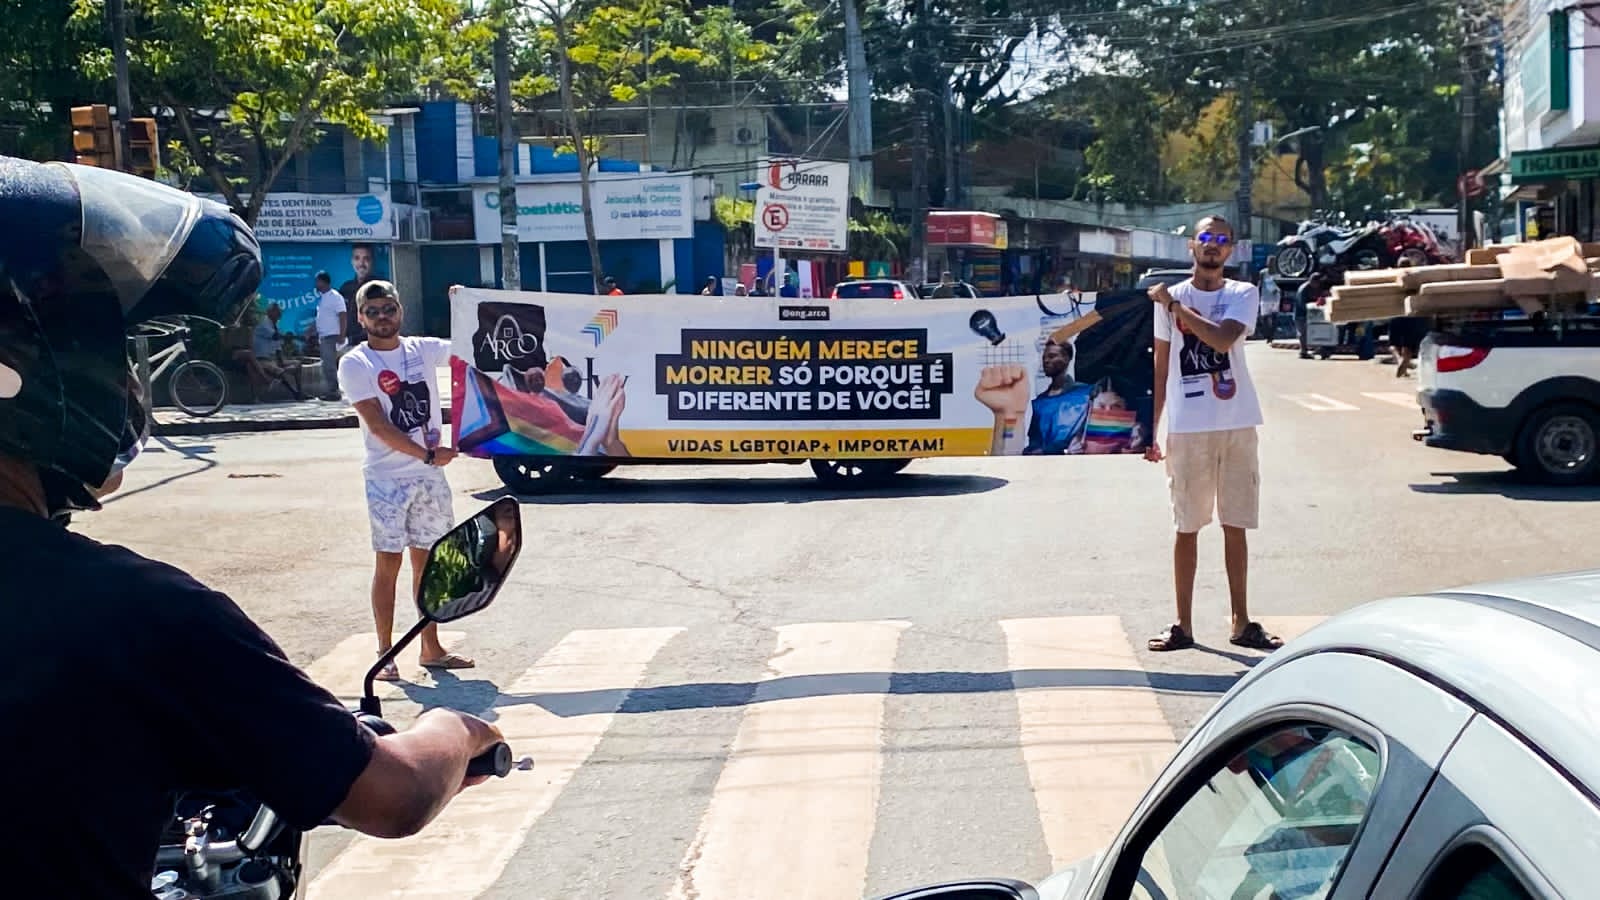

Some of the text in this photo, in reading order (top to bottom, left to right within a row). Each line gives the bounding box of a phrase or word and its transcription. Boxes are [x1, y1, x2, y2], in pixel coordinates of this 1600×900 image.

[768, 161, 829, 191] CARRARA
[285, 219, 318, 227] RESINA
[306, 228, 335, 237] FACIAL
[337, 227, 373, 237] (BOTOX)
[781, 309, 827, 320] @ong.arco
[479, 331, 538, 361] ARCO
[691, 336, 919, 360] NINGUÉM MERECE
[666, 359, 944, 389] MORRER SÓ PORQUE É
[678, 384, 931, 411] DIFERENTE DE VOCÊ!
[668, 438, 944, 454] VIDAS LGBTQIAP+ IMPORTAM!
